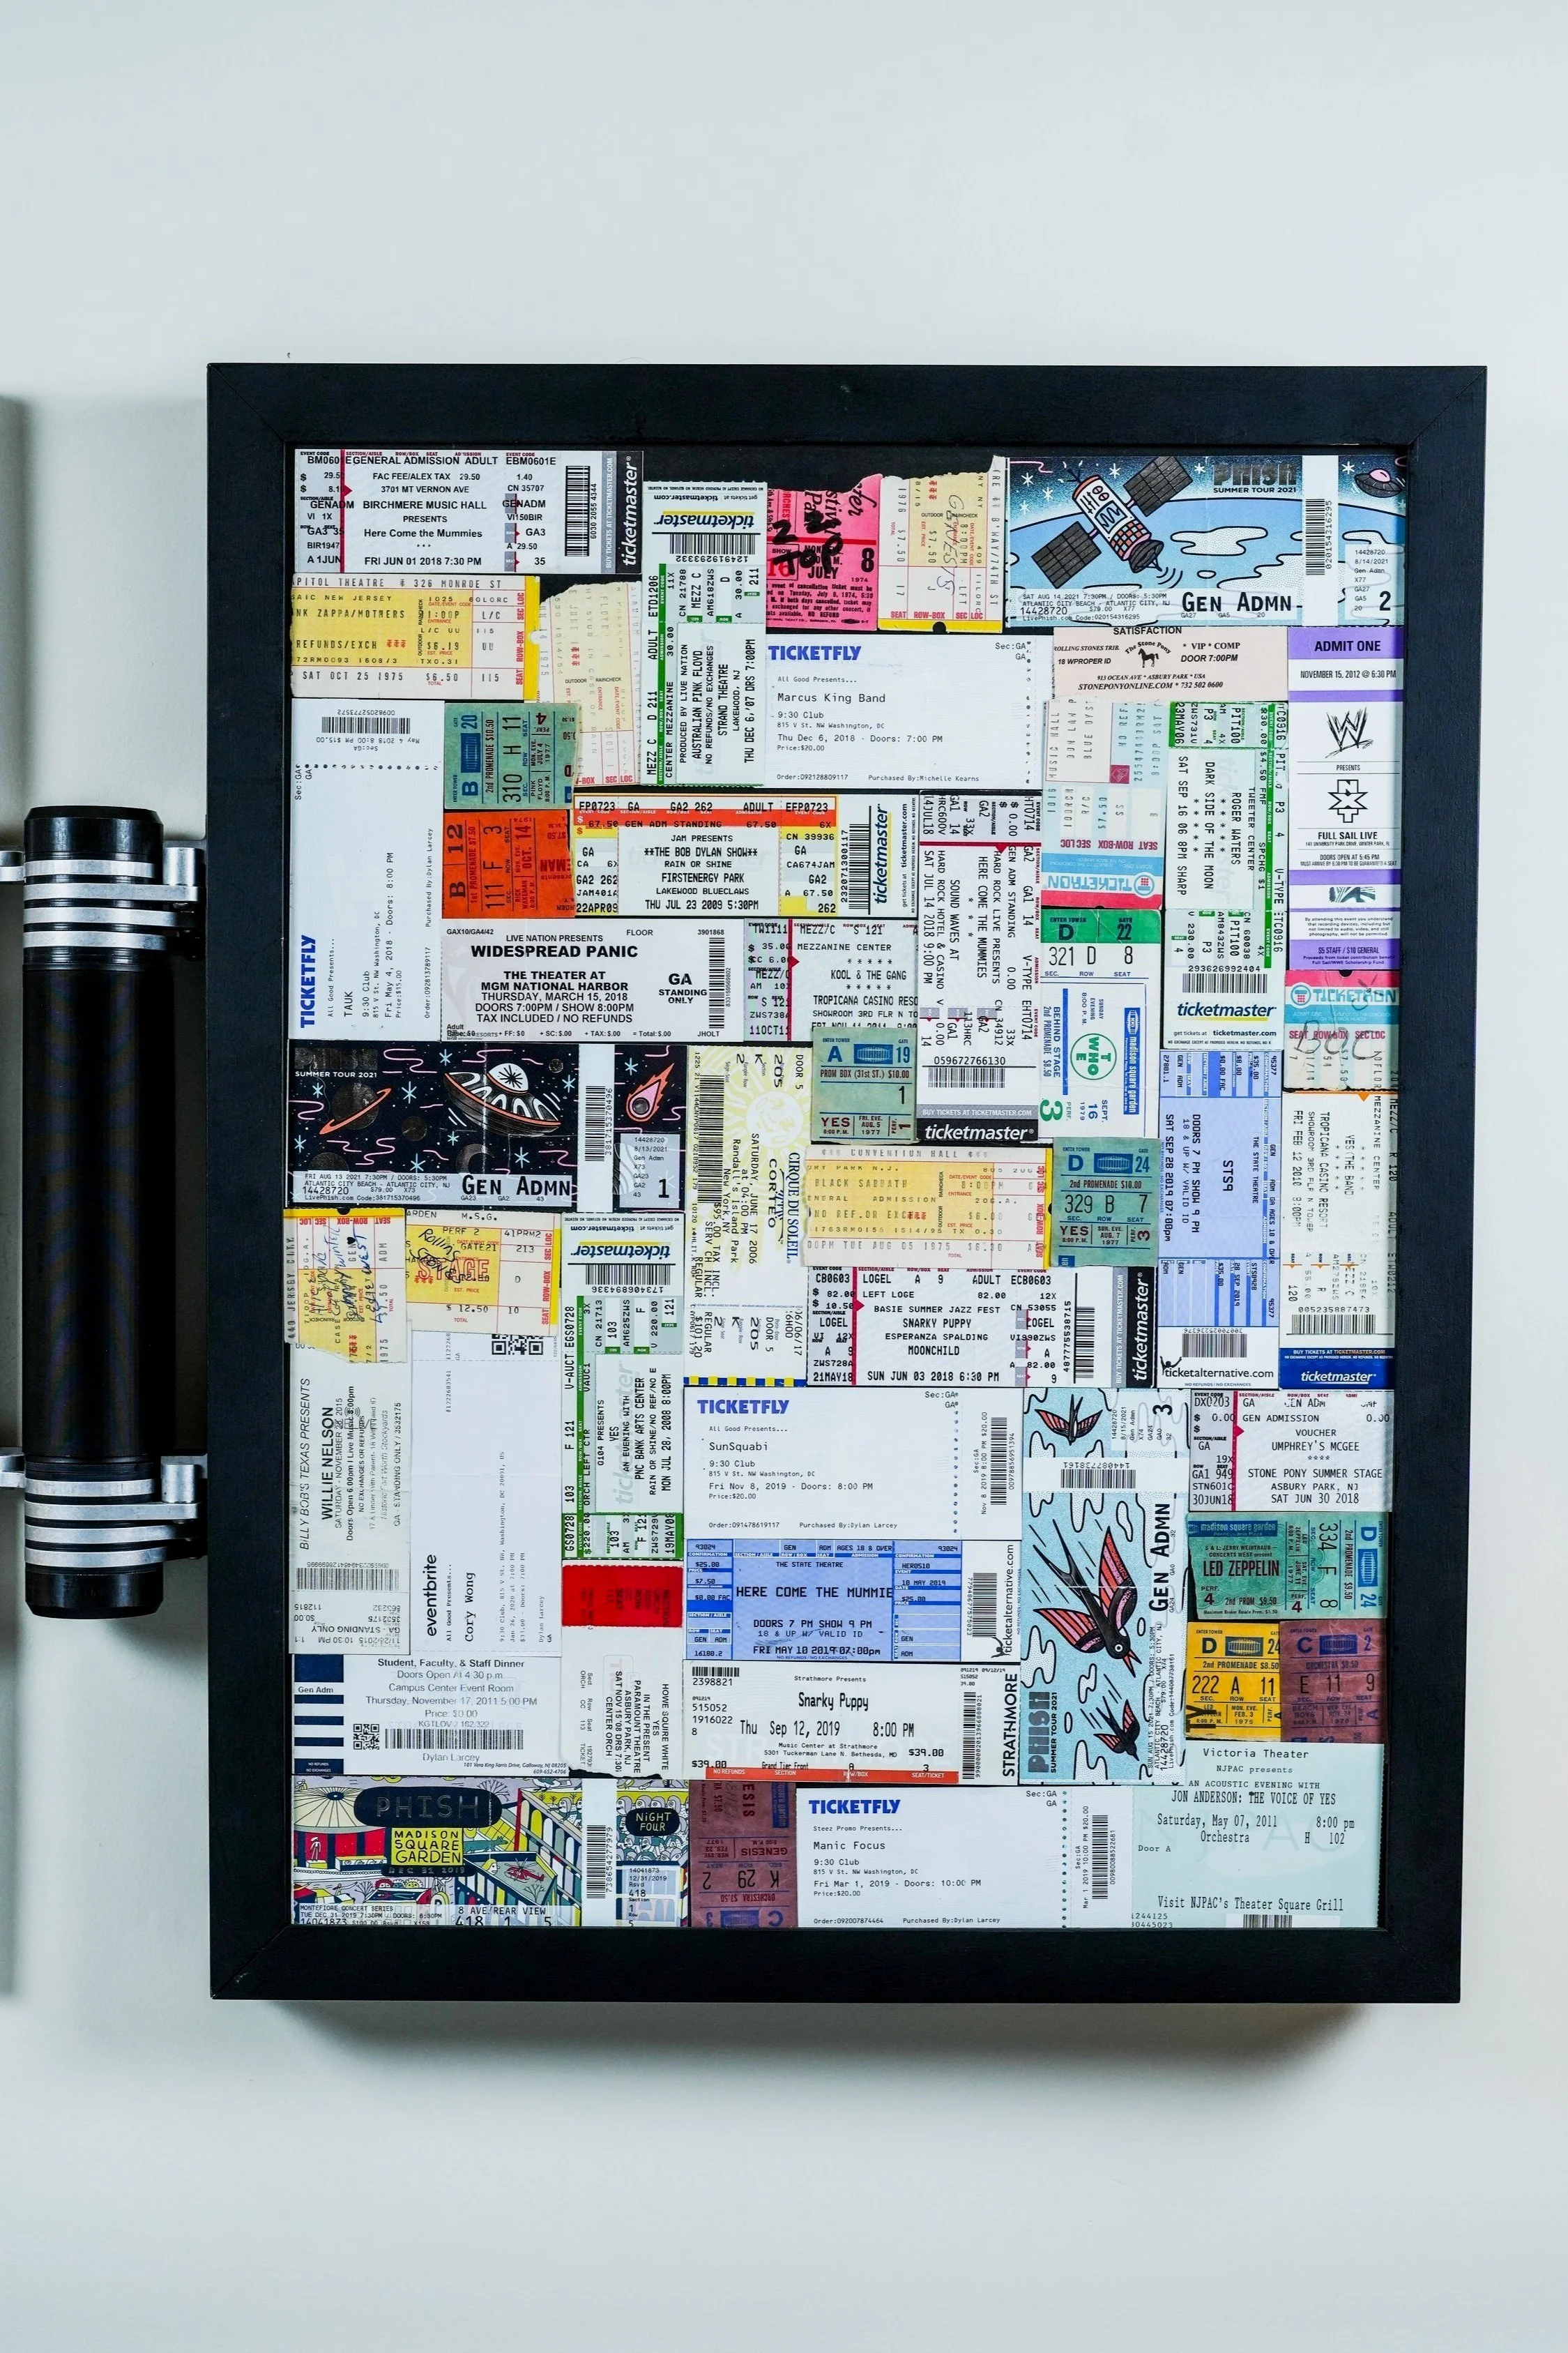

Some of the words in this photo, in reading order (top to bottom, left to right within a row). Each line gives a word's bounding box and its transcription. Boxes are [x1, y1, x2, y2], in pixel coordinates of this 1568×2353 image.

[659, 515, 754, 529] ticketmaster
[860, 546, 877, 574] 8
[889, 610, 906, 620] SEAT
[912, 610, 946, 620] ROW-BOX
[956, 612, 968, 620] SEC
[1111, 626, 1182, 635] SATISFACTION
[767, 645, 865, 661] TICKETFLY
[1315, 641, 1353, 651] ADMIT
[1357, 641, 1380, 651] ONE
[693, 651, 702, 676] FLOYD
[330, 672, 348, 680] OCT
[718, 665, 728, 699] THEATRE
[692, 682, 702, 702] PINK
[778, 693, 816, 702] Marcus
[825, 693, 851, 704] King
[859, 694, 885, 702] Band
[503, 718, 521, 730] 11
[718, 706, 727, 735] STRAND
[692, 708, 701, 759] AUSTRALIAN
[503, 746, 521, 754] H
[1205, 762, 1215, 785] DARK
[502, 774, 522, 802] 310
[1205, 793, 1215, 815] SIDE
[1232, 793, 1241, 822] ROGER
[1205, 823, 1214, 833] OF
[676, 847, 690, 856] BOB
[696, 847, 721, 856] DYLAN
[1205, 841, 1214, 858] THE
[1231, 829, 1240, 864] WATERS
[662, 873, 718, 882] FIRSTENERGY
[724, 873, 744, 882] PARK
[1204, 865, 1214, 888] MOON
[950, 880, 960, 908] SOUND
[950, 914, 959, 943] WAVES
[471, 946, 580, 957] WIDESPREAD
[587, 946, 637, 957] PANIC
[950, 949, 959, 960] AT
[1049, 946, 1073, 966] 321
[1088, 946, 1096, 964] D
[1125, 946, 1132, 964] 8
[300, 935, 315, 1028] TICKETFLY
[831, 970, 851, 979] KOOL
[867, 970, 881, 980] THE
[887, 971, 906, 980] GANG
[344, 992, 353, 1017] TAUK
[296, 1070, 330, 1079] SUMMER
[821, 1117, 849, 1127] YES
[786, 1153, 800, 1196] CIRQUE
[816, 1179, 848, 1187] BLACK
[768, 1159, 779, 1227] CORTEO
[788, 1200, 799, 1216] DU
[1065, 1194, 1093, 1213] 329
[1106, 1195, 1114, 1213] B
[1139, 1195, 1148, 1213] 7
[787, 1219, 798, 1259] SOLEIL
[904, 1318, 936, 1328] SNARKY
[943, 1319, 971, 1328] PUPPY
[908, 1346, 959, 1355] MOONCHILD
[1164, 1367, 1273, 1377] ticketalternative.com
[1301, 1371, 1376, 1381] ticketmaster
[635, 1378, 644, 1408] CENTER
[635, 1414, 644, 1434] ARTS
[322, 1408, 334, 1467] NELSON
[1272, 1441, 1325, 1451] UMPHREY'S
[1331, 1442, 1359, 1451] MCGEE
[635, 1440, 644, 1459] BANK
[710, 1442, 767, 1452] SunSquabi
[635, 1465, 644, 1479] PNC
[321, 1472, 333, 1520] WILLIE
[1204, 1561, 1223, 1576] LED
[1228, 1560, 1279, 1577] ZEPPELIN
[424, 1554, 436, 1636] eventbrite
[465, 1573, 475, 1603] Wong
[737, 1587, 767, 1596] HERE
[776, 1587, 807, 1597] COME
[816, 1587, 839, 1597] THE
[465, 1611, 475, 1642] Cory
[1192, 1675, 1219, 1693] 222
[1231, 1677, 1239, 1694] A
[1261, 1677, 1274, 1695] 11
[799, 1692, 833, 1711] Snarky
[1003, 1674, 1019, 1778] STRATHMORE
[1203, 1748, 1255, 1757] Victoria
[1263, 1749, 1309, 1758] Theater
[1172, 1790, 1188, 1802] JON
[1194, 1791, 1241, 1803] ANDERSON:
[1249, 1792, 1264, 1803] THE
[1271, 1792, 1297, 1804] VOICE
[1304, 1793, 1314, 1804] OF
[1320, 1793, 1335, 1805] YES
[809, 1799, 900, 1815] TICKETFLY
[395, 1831, 458, 1839] MADISON
[814, 1841, 845, 1849] Manic
[396, 1850, 460, 1863] GARDEN
